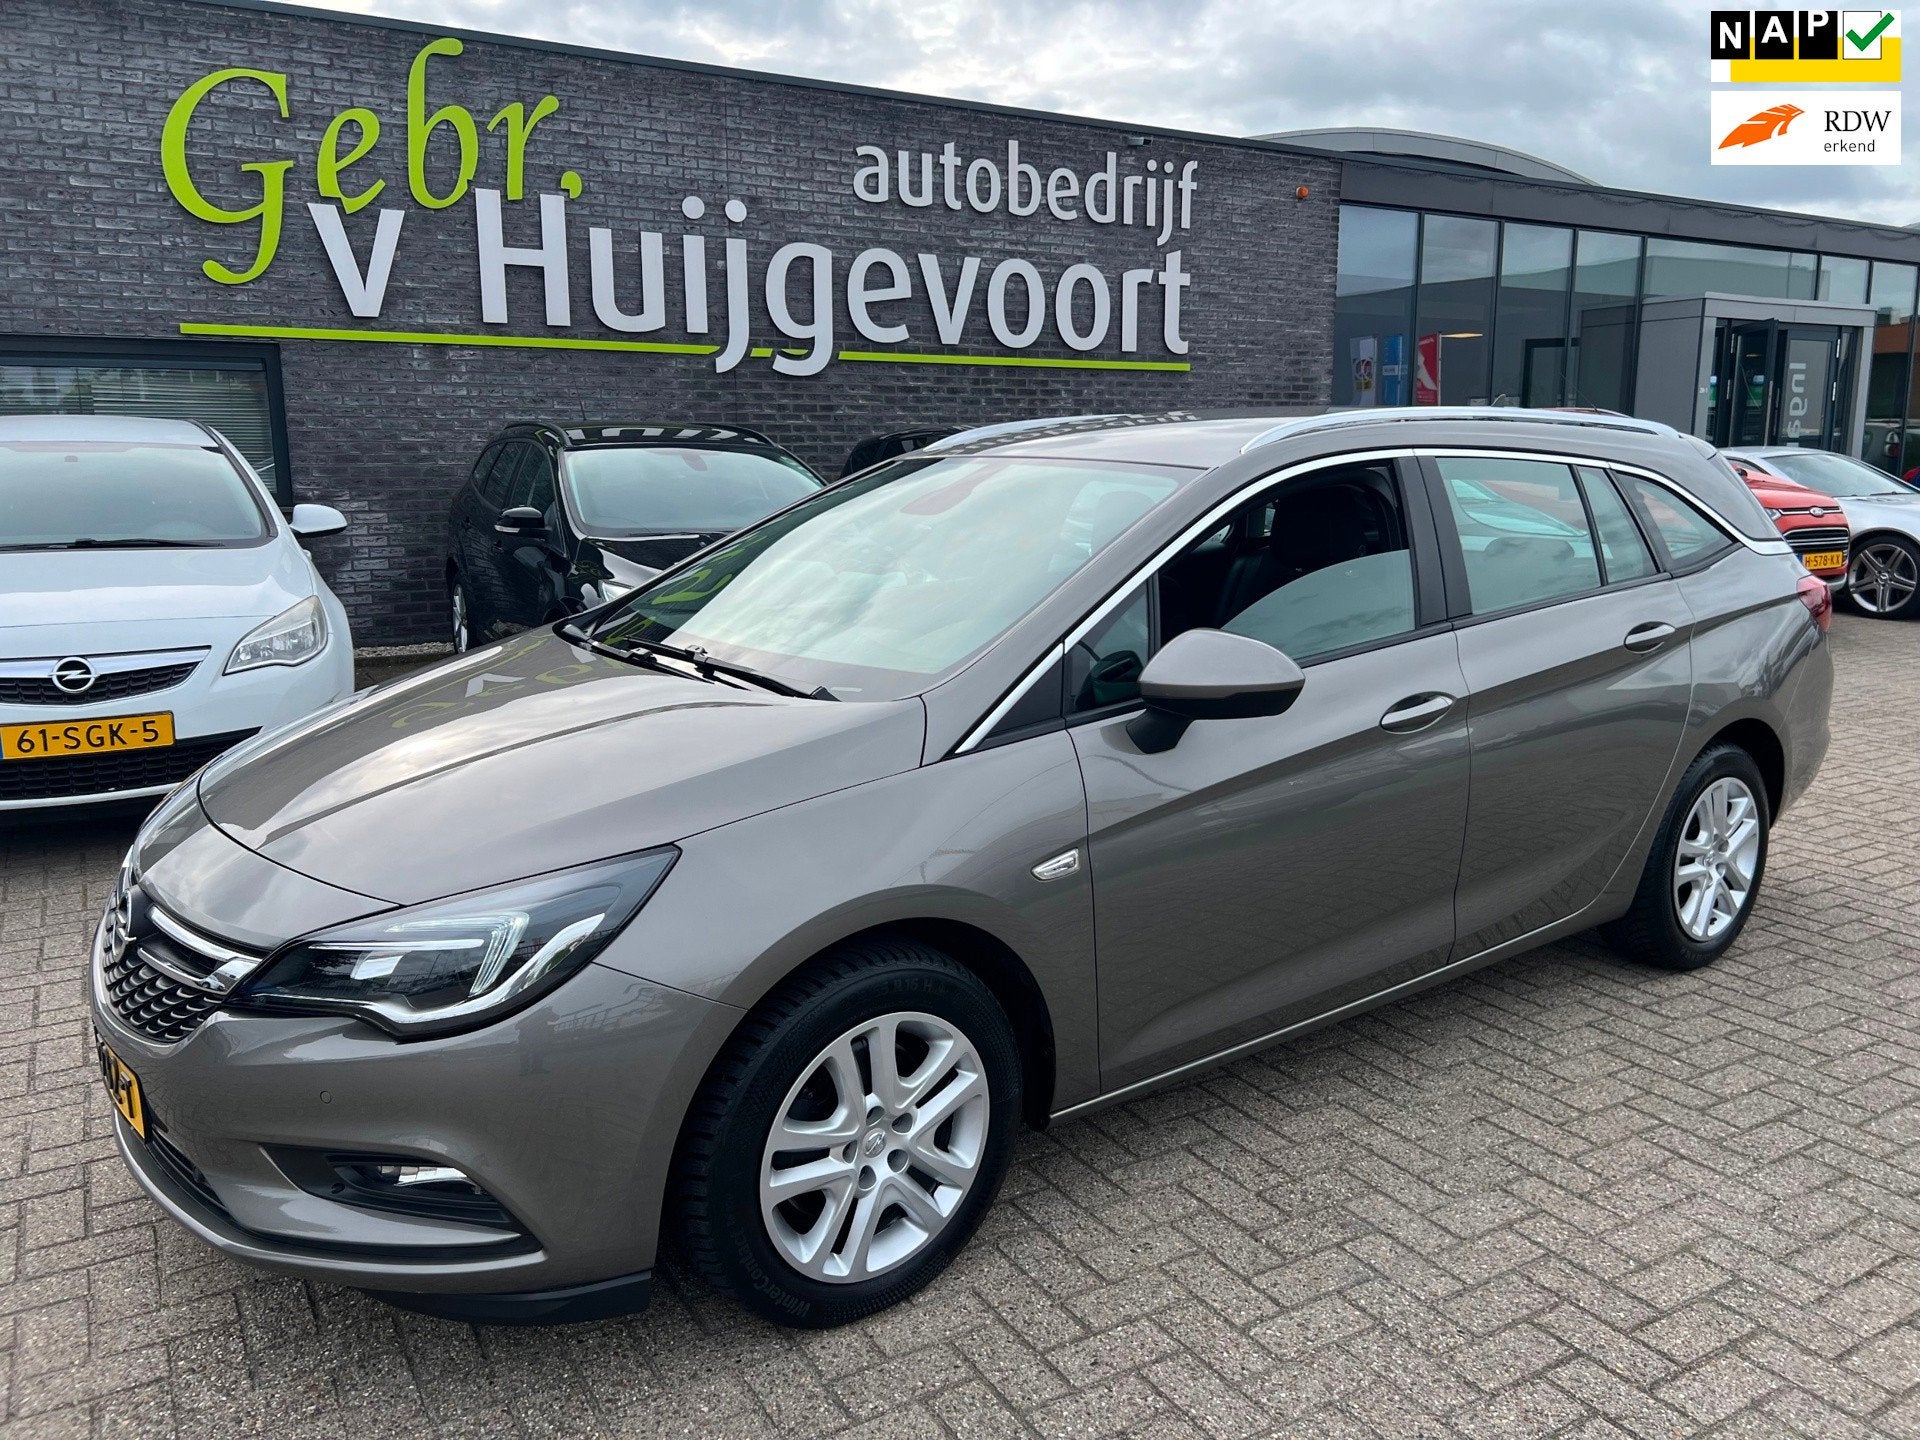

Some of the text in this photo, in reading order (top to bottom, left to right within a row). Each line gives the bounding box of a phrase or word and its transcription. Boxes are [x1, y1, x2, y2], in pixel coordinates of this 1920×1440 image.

[852, 140, 1198, 247] autobedrijf
[475, 188, 1191, 376] Huijgevoort
[16, 719, 159, 754] 61-SGK-5
